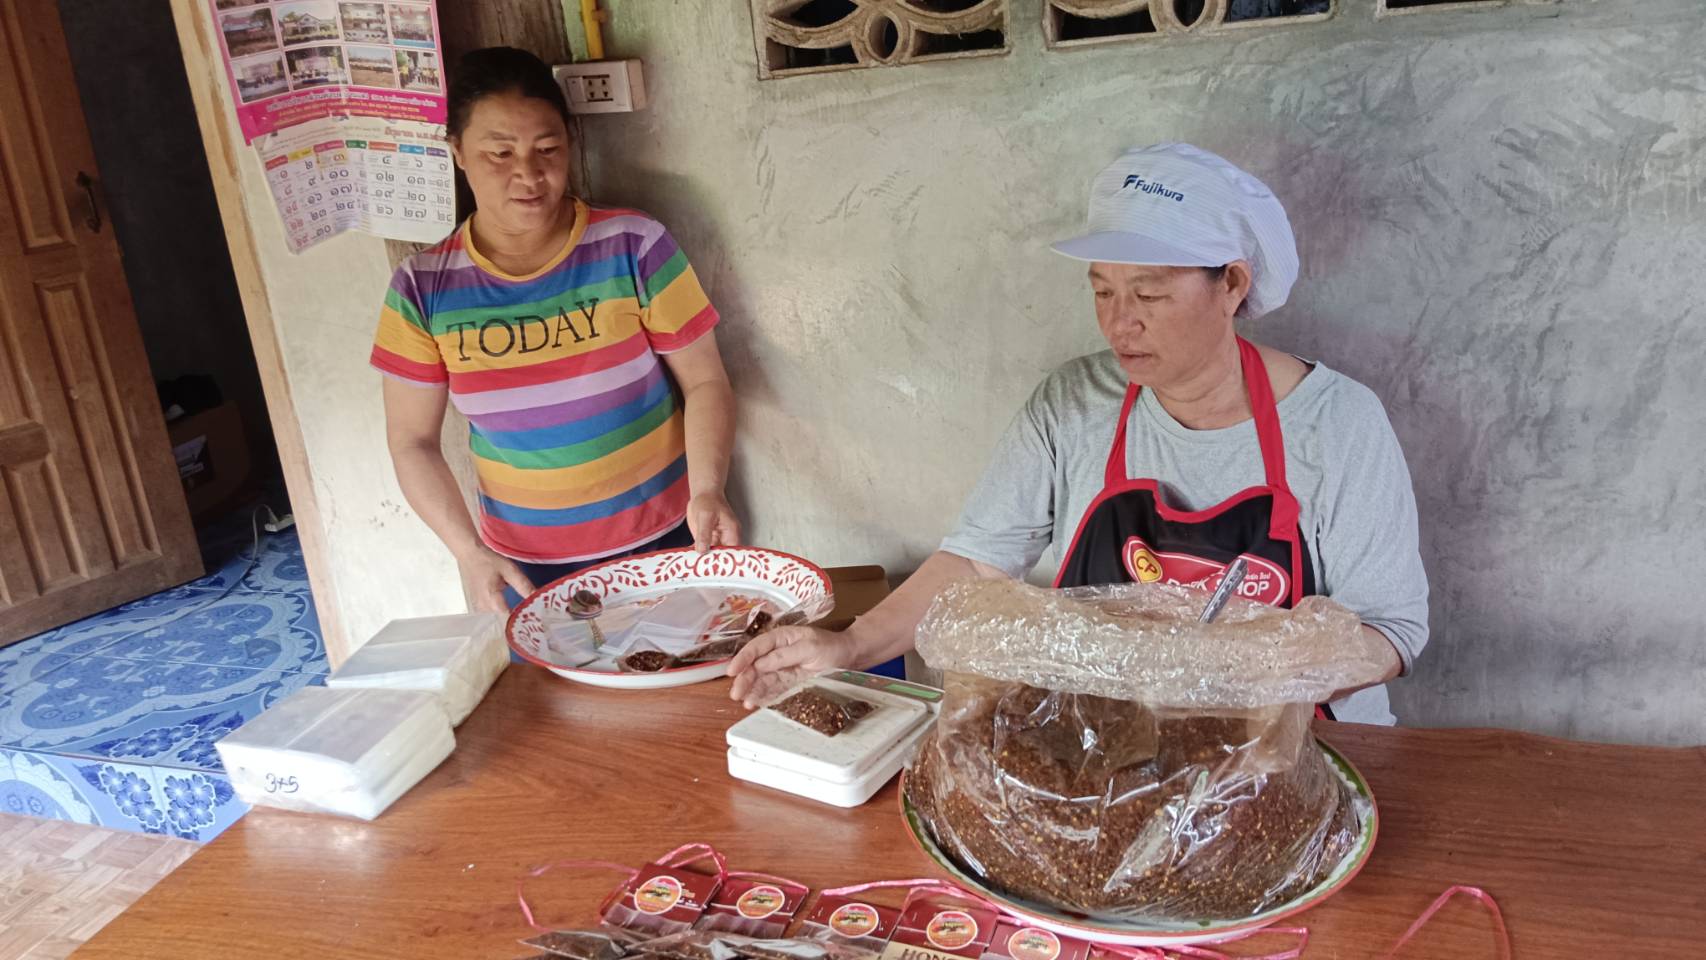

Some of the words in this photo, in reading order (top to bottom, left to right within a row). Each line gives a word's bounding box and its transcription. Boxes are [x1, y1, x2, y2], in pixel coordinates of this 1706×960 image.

[1134, 179, 1184, 202] Fujikura
[446, 297, 600, 361] TODAY
[1136, 556, 1158, 575] CP
